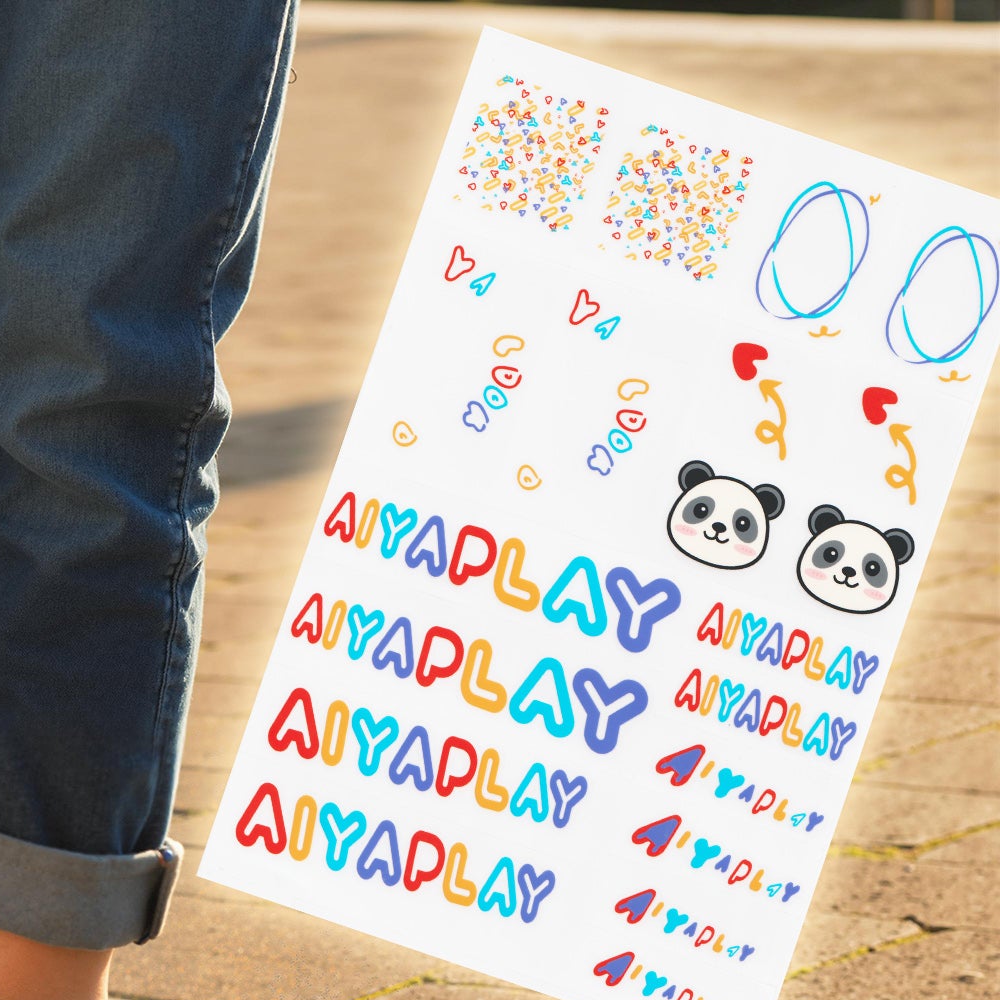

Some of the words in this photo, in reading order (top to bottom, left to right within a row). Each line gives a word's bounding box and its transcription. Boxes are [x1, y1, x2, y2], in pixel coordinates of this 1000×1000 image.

[324, 492, 681, 652] AIYAPLAY
[291, 593, 648, 754] AIYAPLAY
[697, 602, 879, 694] AIYAPLAY
[268, 688, 587, 828] AIYAPLAY
[674, 668, 856, 760] AIYAPLAY
[655, 744, 824, 831] AIYAPLAY
[235, 782, 555, 923] AIYAPLAY
[632, 815, 800, 902] AIYAPLAY
[614, 889, 754, 961] AIYAPLAY
